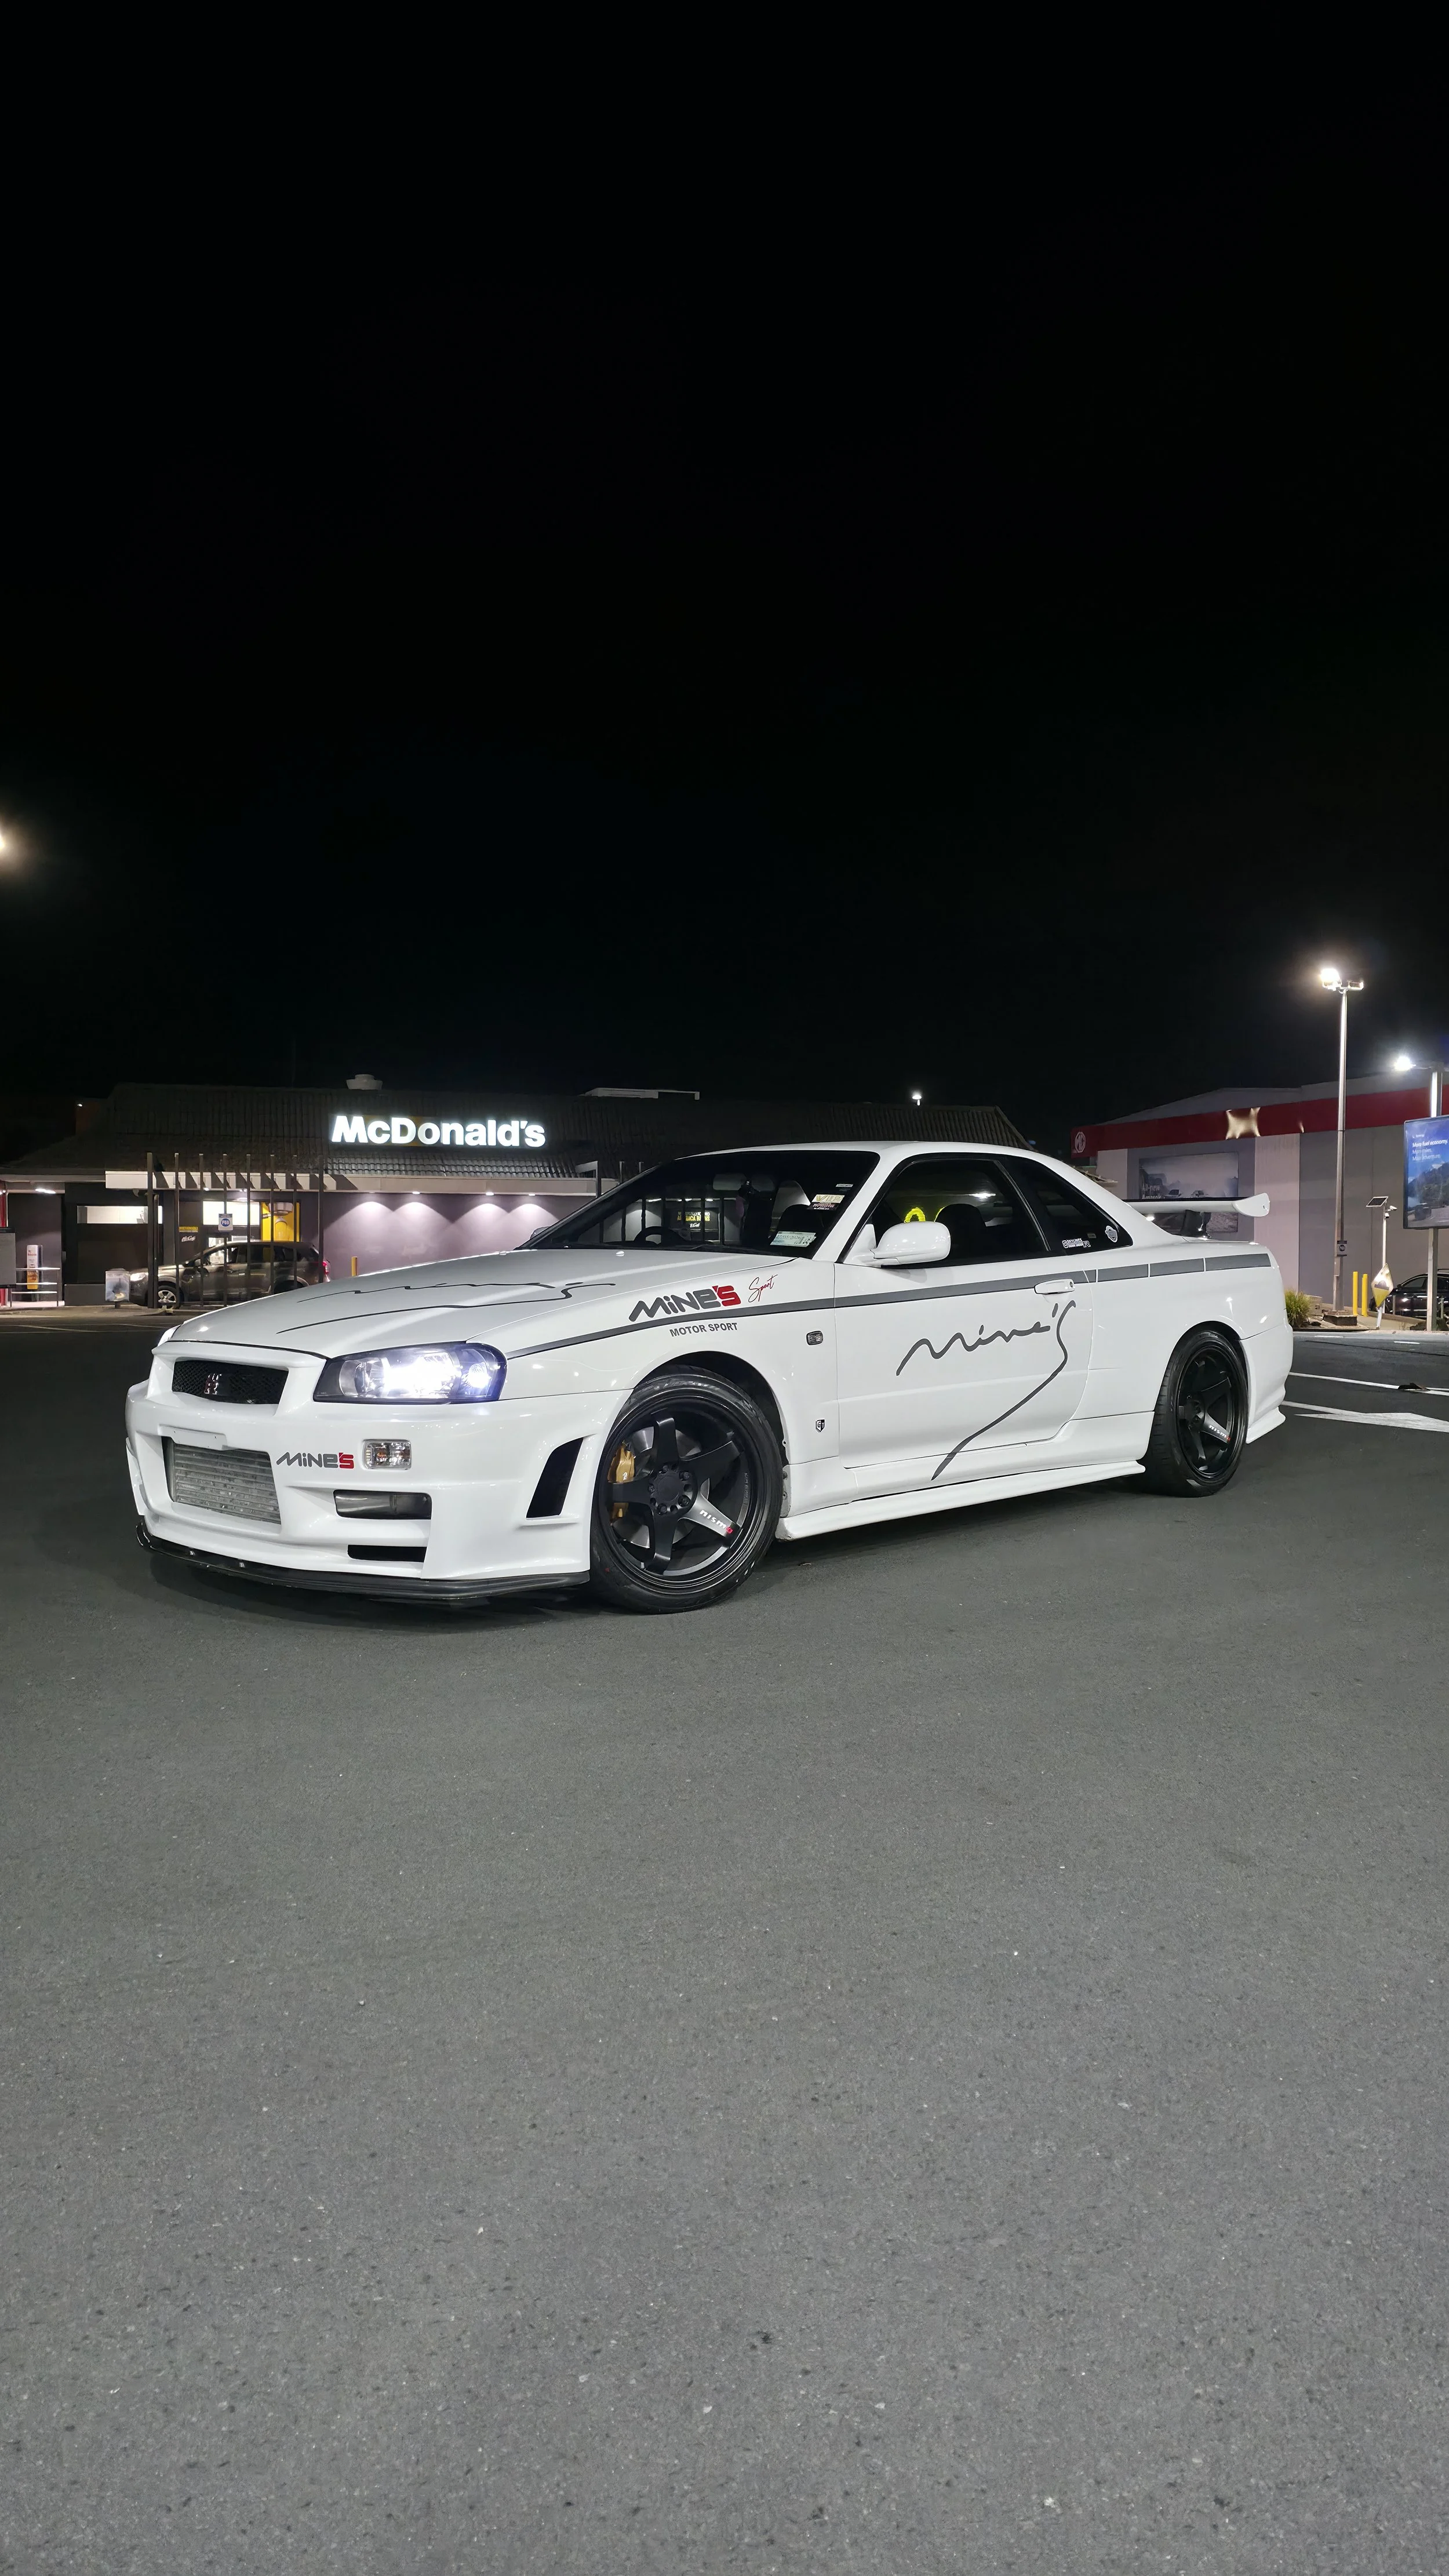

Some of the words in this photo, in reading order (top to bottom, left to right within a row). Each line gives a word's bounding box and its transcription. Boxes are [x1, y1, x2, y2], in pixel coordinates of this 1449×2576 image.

[331, 1115, 546, 1147] McDonald's
[1142, 1183, 1160, 1191] All-new
[748, 1274, 778, 1303] Sport
[669, 1324, 707, 1337] MOTOR
[708, 1322, 738, 1332] SPORT
[1208, 1425, 1232, 1441] nismo
[700, 1510, 733, 1534] nismo
